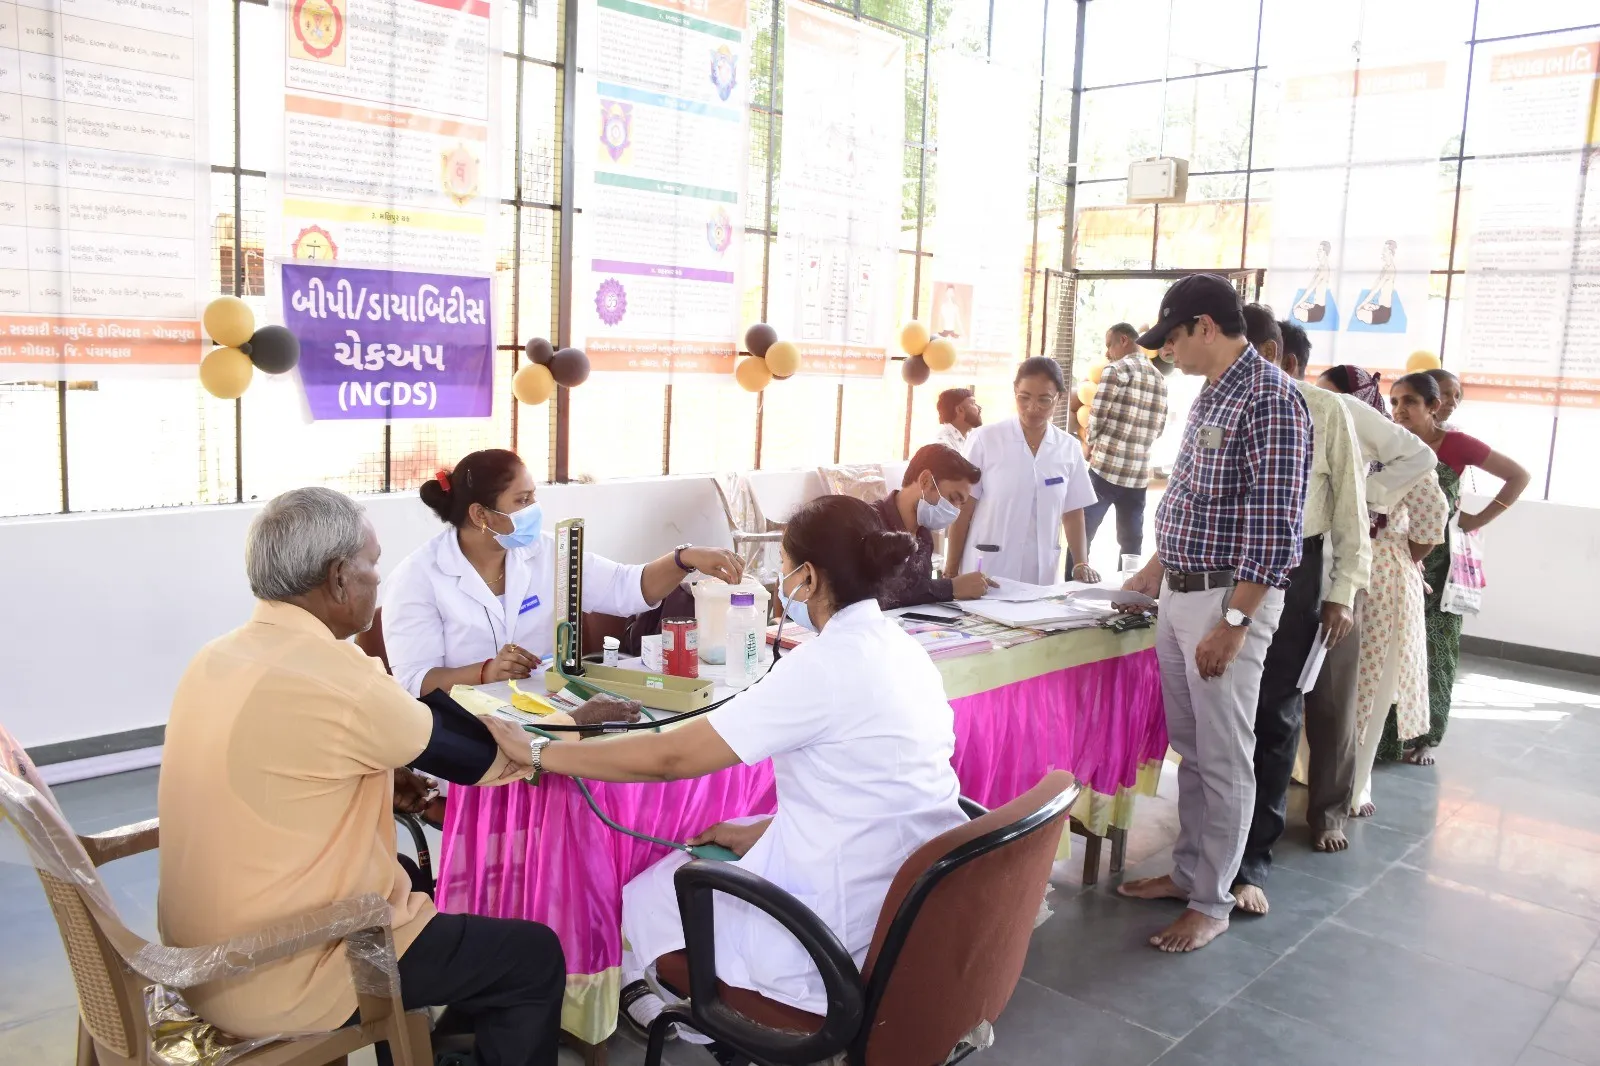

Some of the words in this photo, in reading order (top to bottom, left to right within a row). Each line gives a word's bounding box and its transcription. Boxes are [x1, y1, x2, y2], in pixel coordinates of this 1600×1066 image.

[291, 277, 486, 325] બીપી/ડાયાબિટીસ
[9, 322, 50, 337] સરકારી
[334, 329, 446, 371] ચેકઅપ
[338, 381, 437, 411] (NCDS)
